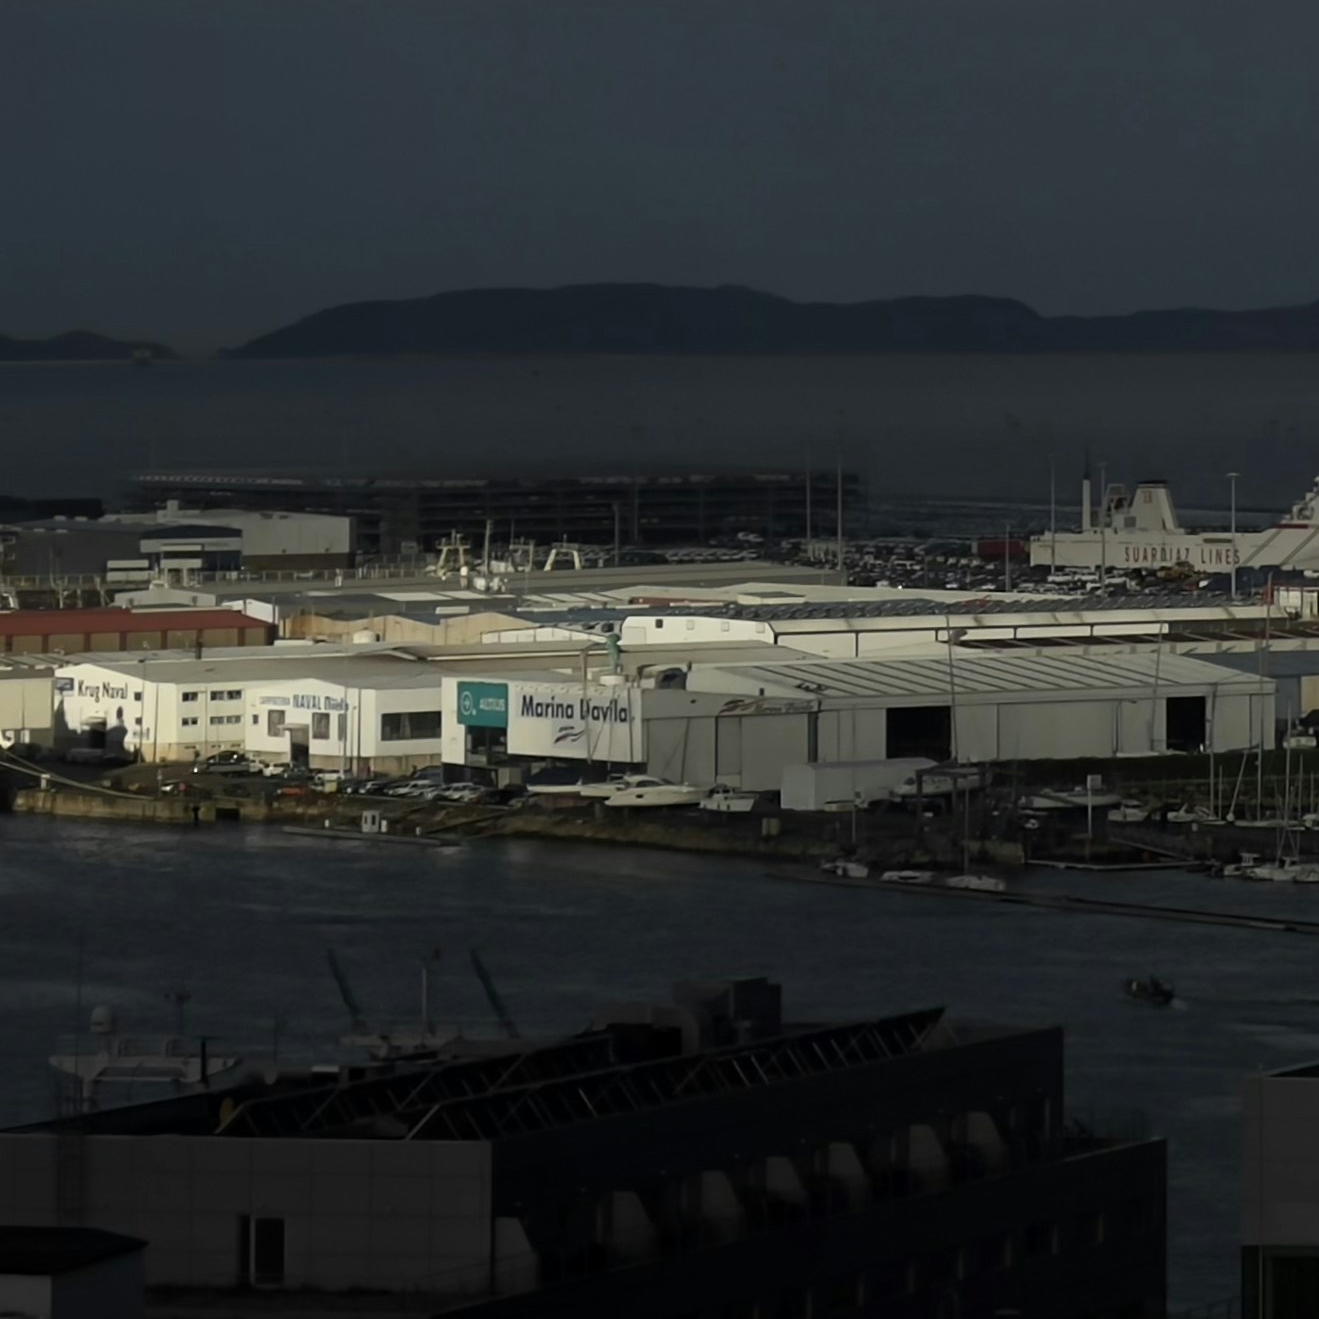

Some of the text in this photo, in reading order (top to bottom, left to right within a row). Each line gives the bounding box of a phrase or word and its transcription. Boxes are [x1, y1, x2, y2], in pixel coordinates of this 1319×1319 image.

[1124, 546, 1240, 565] SUARDIAZ LINES
[78, 680, 128, 703] Krug Naval
[293, 694, 322, 710] NAVAL
[521, 694, 575, 719] Marina
